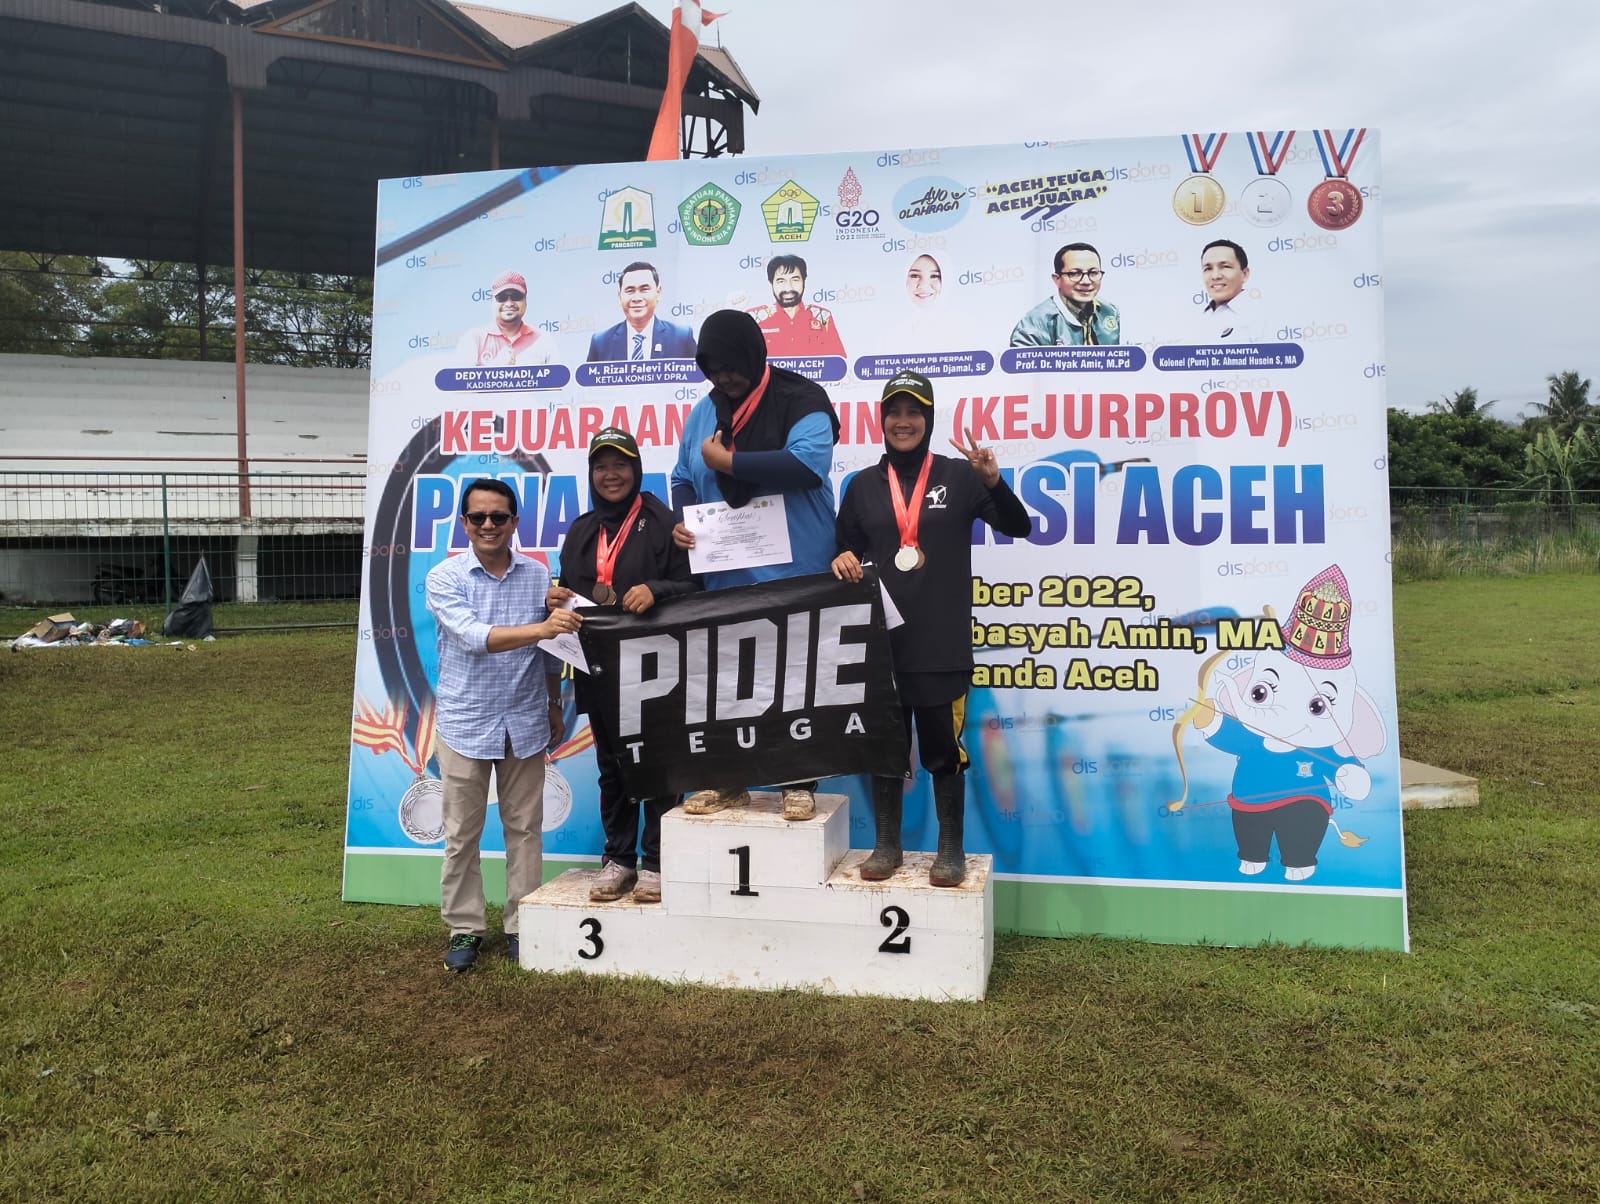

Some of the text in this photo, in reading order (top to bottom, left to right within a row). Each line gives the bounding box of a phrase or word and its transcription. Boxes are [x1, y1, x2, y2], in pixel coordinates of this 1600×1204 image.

[911, 187, 948, 206] AYO
[836, 209, 880, 228] G20
[778, 233, 802, 241] ACEH
[836, 227, 880, 235] INDONESIA
[1016, 349, 1130, 359] KETUA UMUM PERPANI ACEH
[1196, 347, 1259, 356] KETUA PANITIA
[588, 361, 697, 375] M. Rizal Falevi Kirani
[773, 360, 825, 368] KONI ACEH
[875, 355, 973, 366] KETUA UMUM PB PERPANI
[1015, 358, 1130, 371] Prof. Dr. Nyak Amir, M.Pd
[1159, 355, 1297, 368] Kolonel (Purn) Dr. Ahmad Husein S, MA
[455, 368, 551, 381] DEDY YUSMADI, AP
[595, 375, 622, 384] KETUA
[624, 373, 655, 382] KOMISI
[664, 372, 688, 381] DPRA
[861, 367, 873, 378] Hj.
[943, 363, 974, 375] Djamal,
[976, 362, 986, 371] SE
[466, 380, 539, 391] KADISPORA ACEH
[443, 403, 693, 453] KEJUARAAN
[953, 391, 1293, 448] (KEJURPROV)
[1117, 464, 1326, 547] ACEH
[1040, 576, 1155, 610] 2022,
[971, 617, 1285, 653] basyah Amin, MA
[619, 603, 872, 737] PIDIE
[971, 658, 1159, 691] anda Aceh
[626, 712, 866, 764] TEUGA
[728, 845, 759, 896] 1
[878, 905, 911, 954] 2
[577, 917, 605, 959] 3
